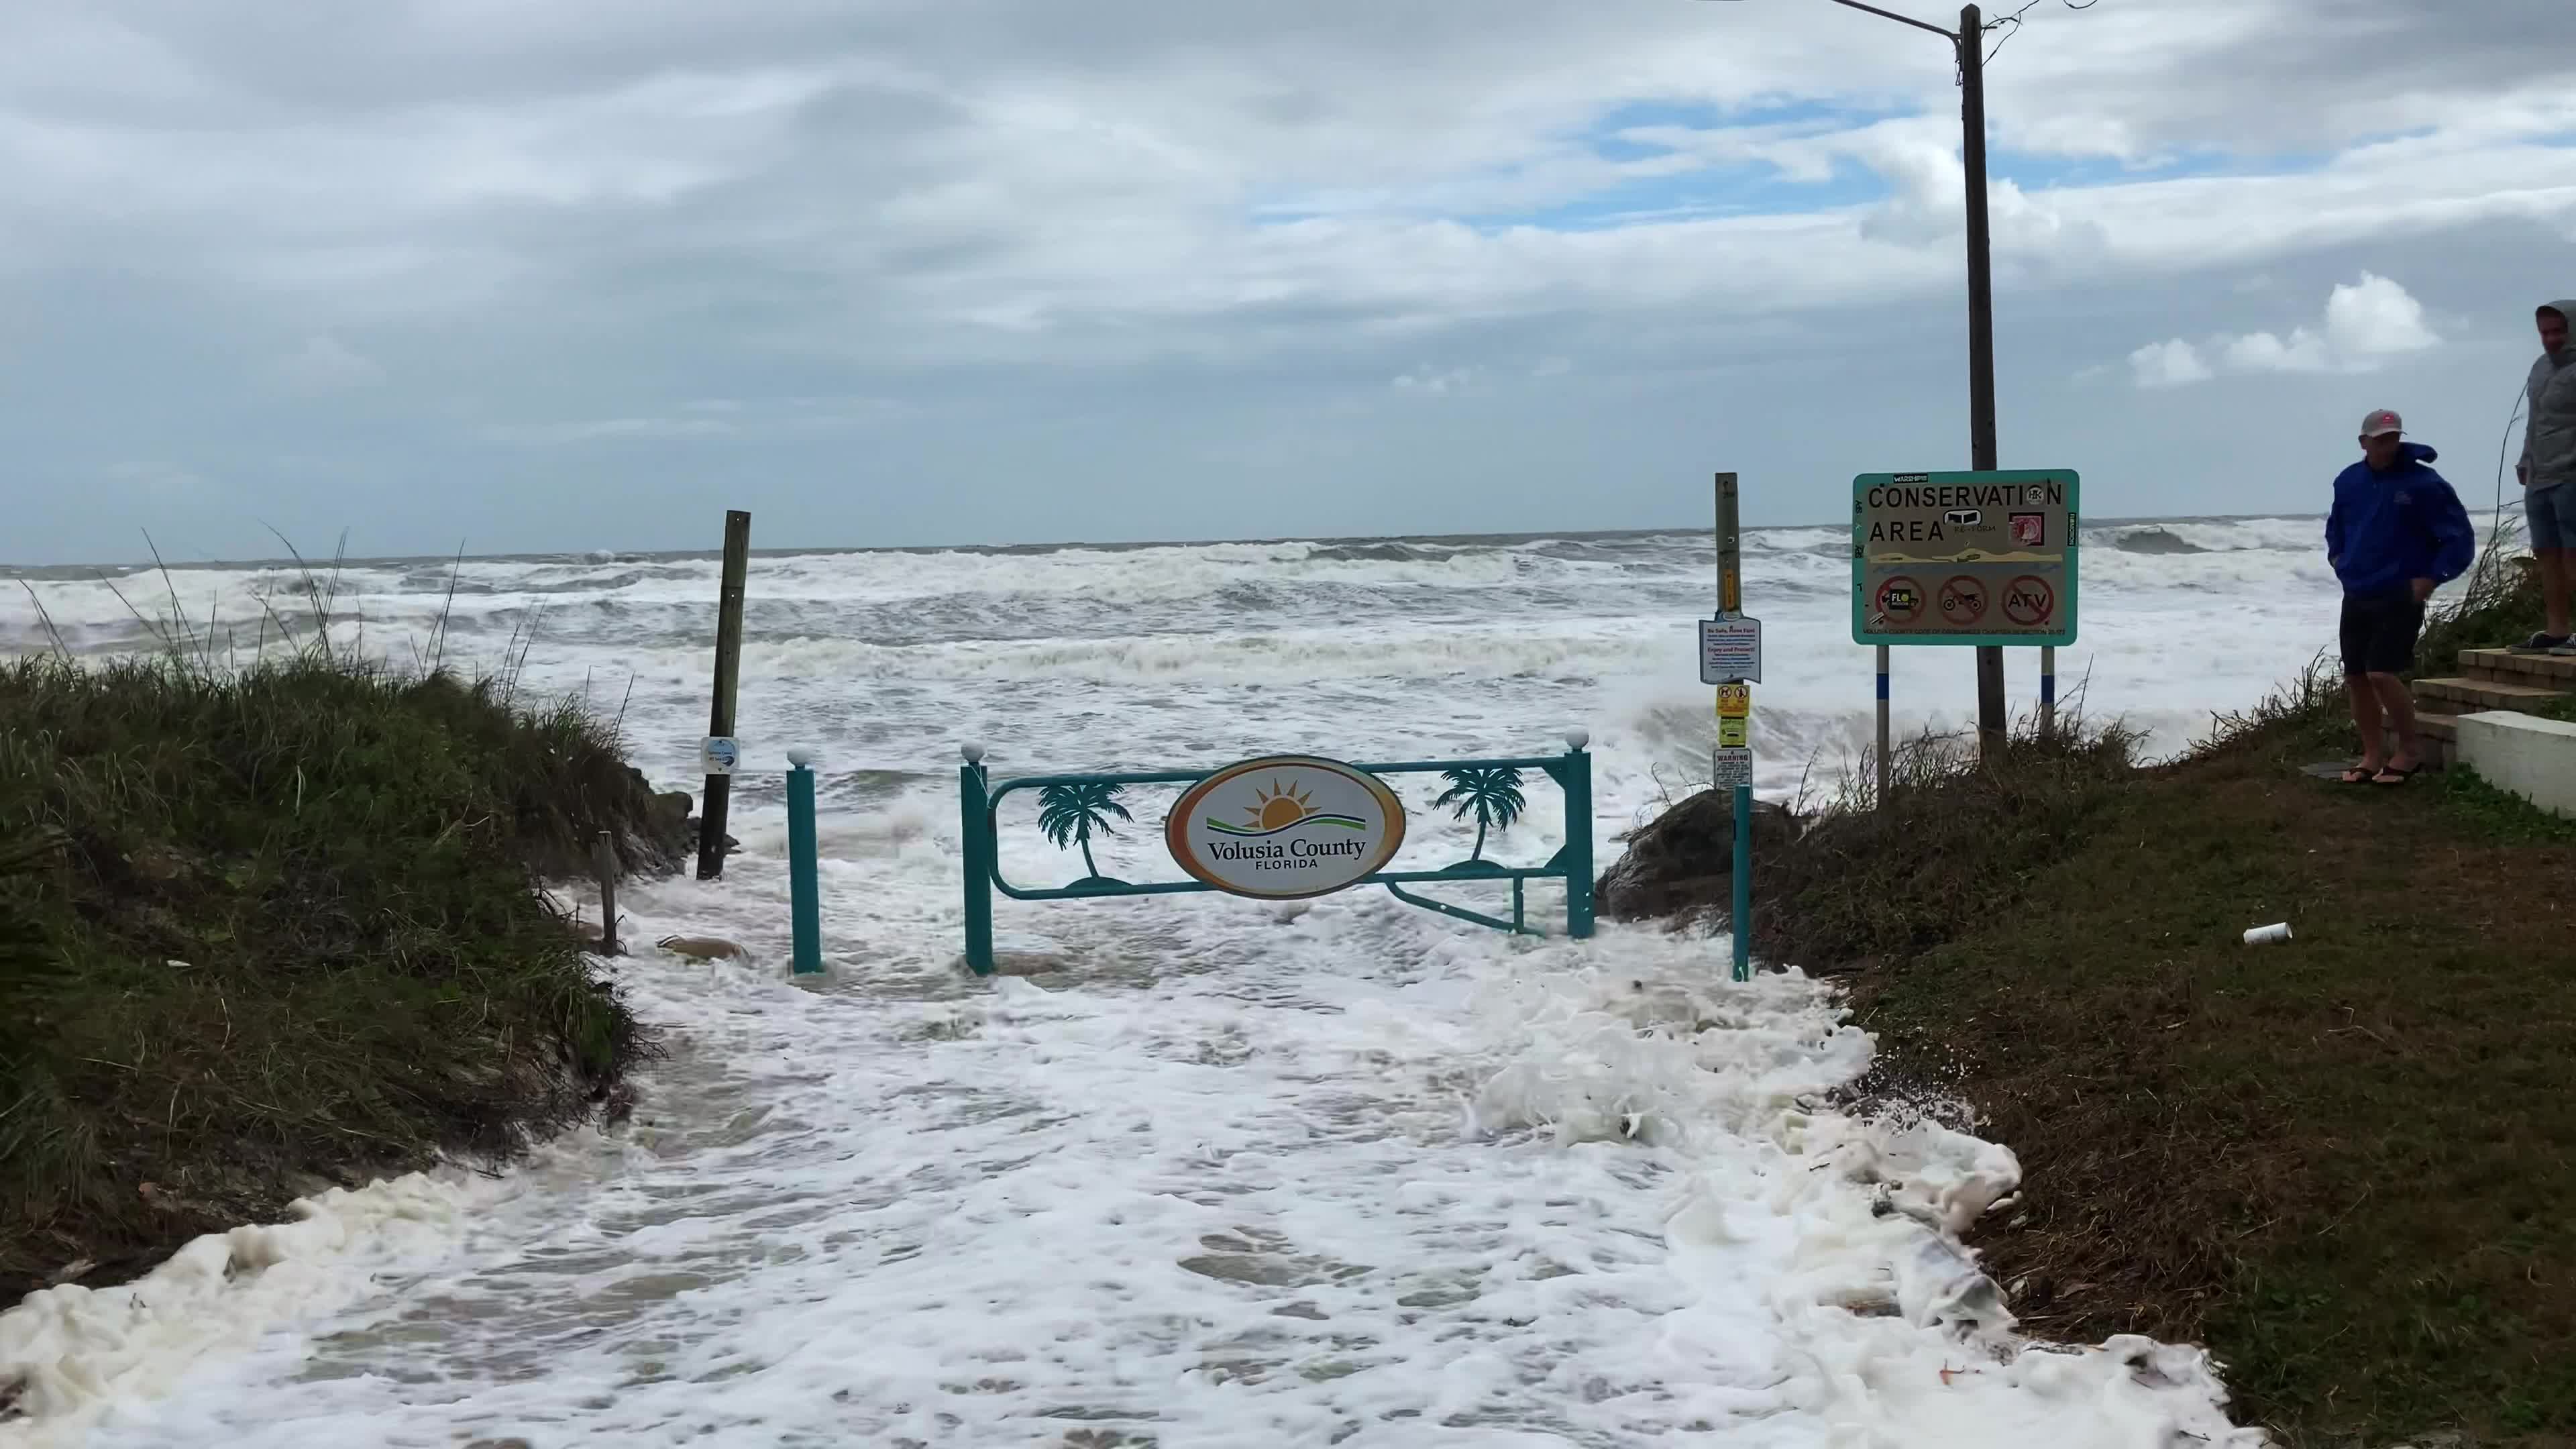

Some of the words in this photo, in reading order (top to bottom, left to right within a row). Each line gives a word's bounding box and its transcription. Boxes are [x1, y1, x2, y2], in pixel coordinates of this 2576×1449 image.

[1869, 521, 1944, 542] AREA
[2008, 593, 2047, 608] ATV
[1208, 840, 1284, 860] Volusia
[1290, 838, 1366, 860] County
[1256, 859, 1318, 870] FLORIDA
